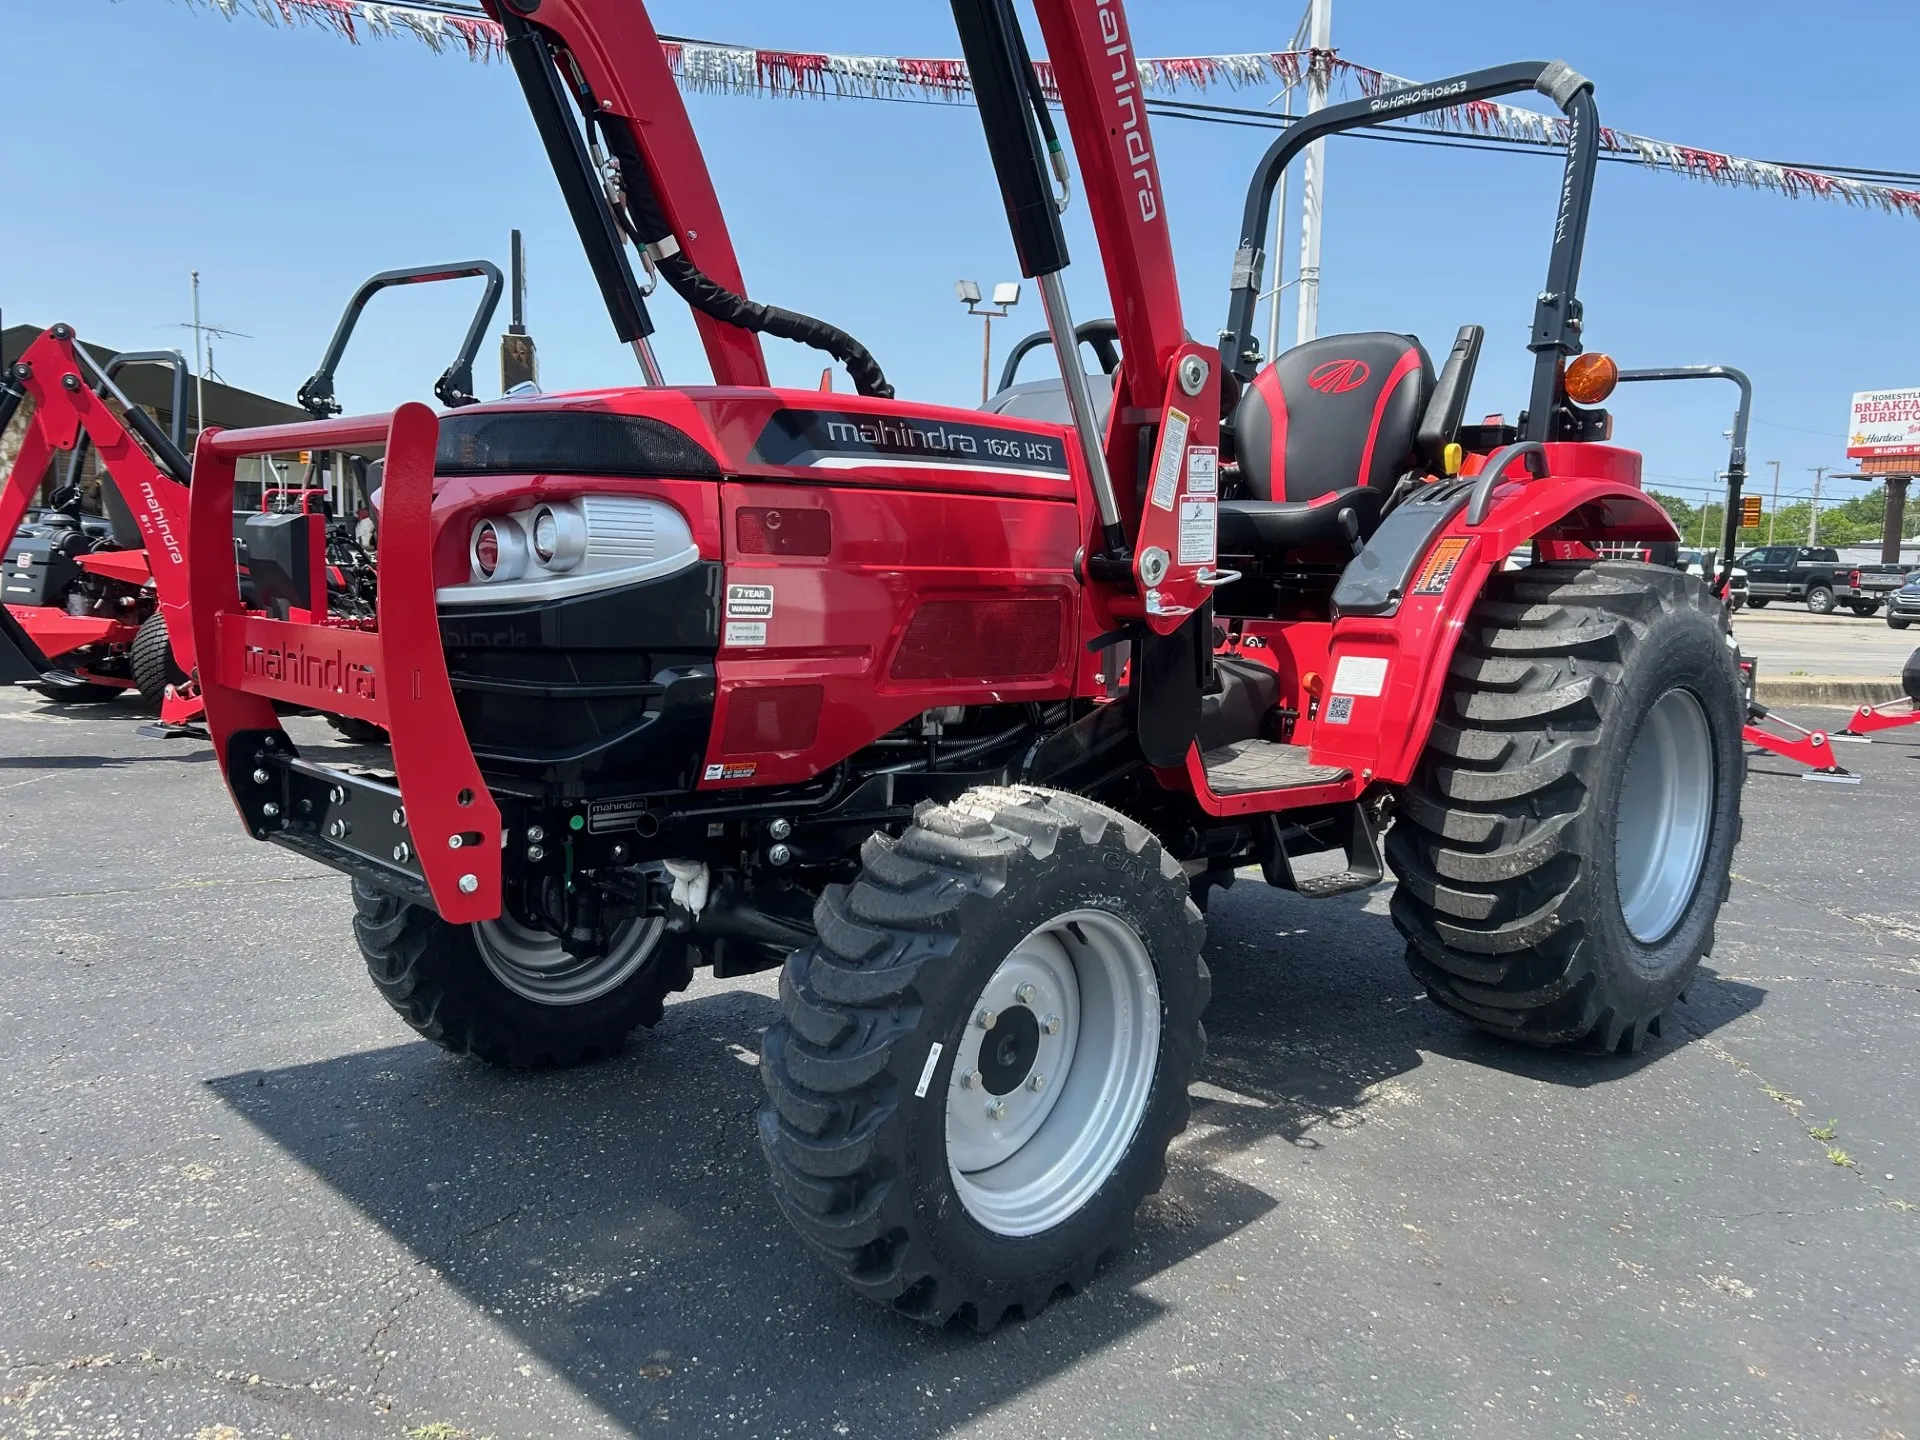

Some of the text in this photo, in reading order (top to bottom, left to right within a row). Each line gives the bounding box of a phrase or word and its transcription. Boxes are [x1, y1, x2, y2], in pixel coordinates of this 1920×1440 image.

[1096, 0, 1157, 222] ahindra
[827, 420, 1052, 462] mahindra 1626 HST
[140, 482, 183, 564] mahindra
[731, 605, 768, 613] WARRANTY
[737, 588, 765, 598] 7 YEAR
[245, 642, 375, 700] mahindra
[593, 801, 643, 812] mahindra
